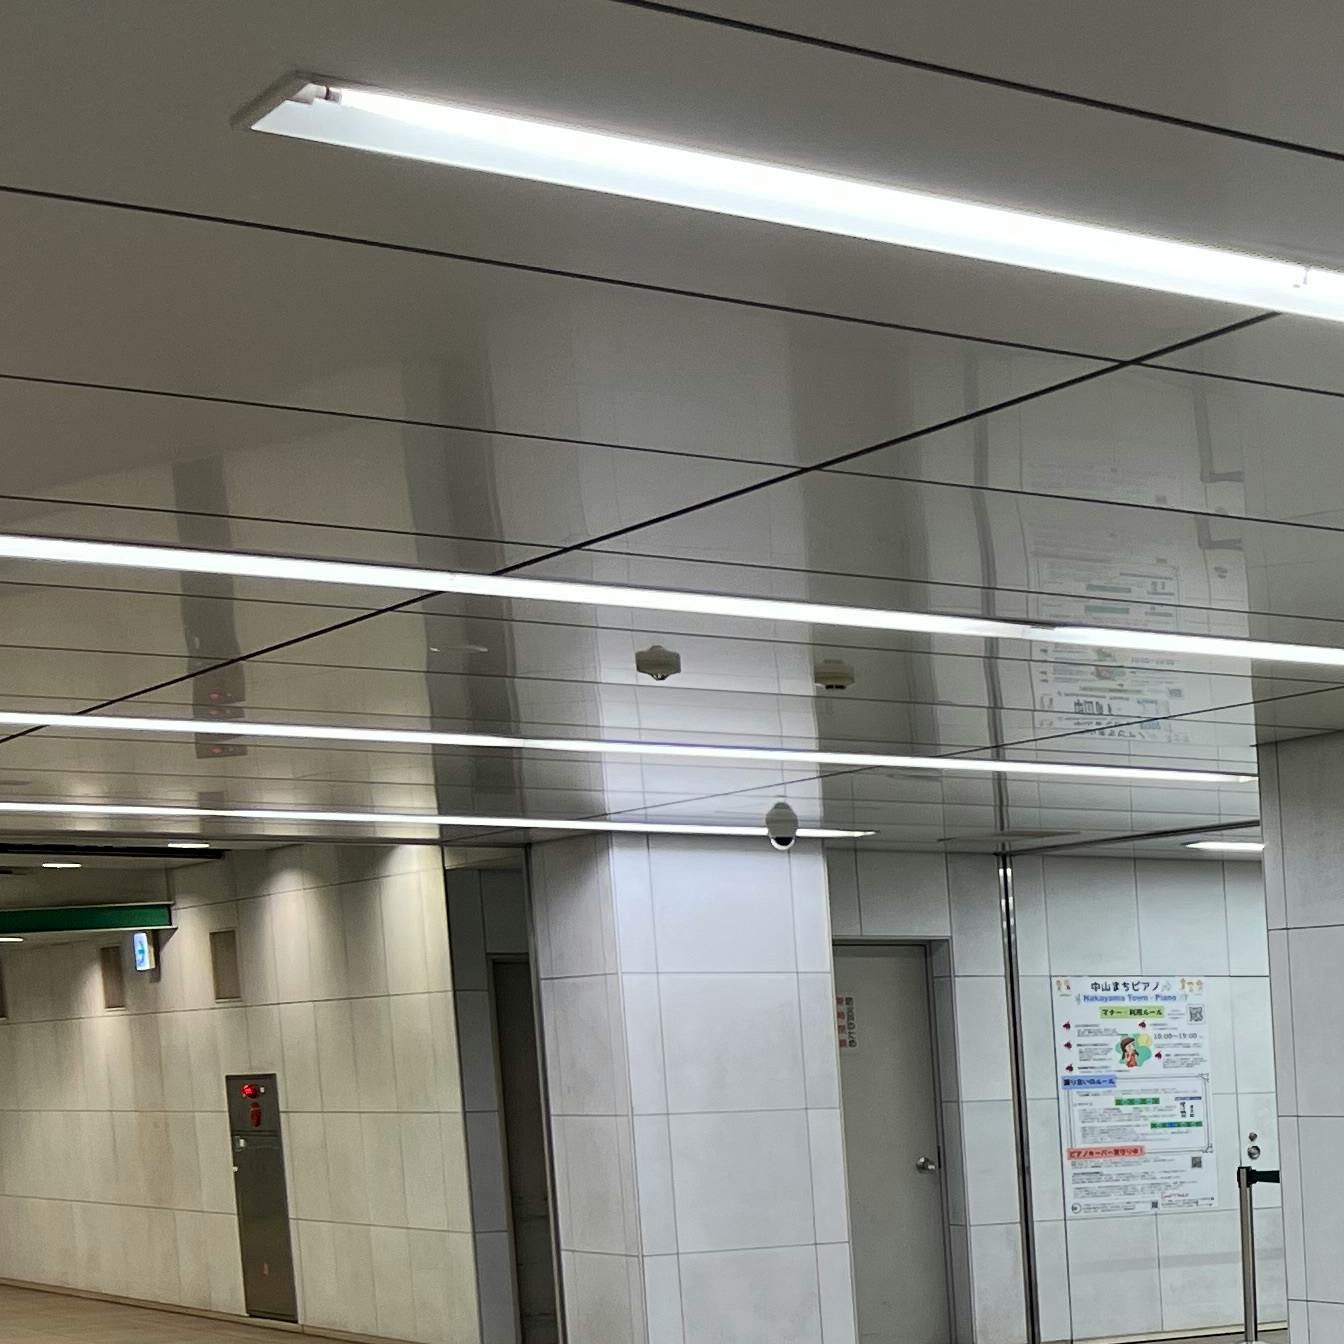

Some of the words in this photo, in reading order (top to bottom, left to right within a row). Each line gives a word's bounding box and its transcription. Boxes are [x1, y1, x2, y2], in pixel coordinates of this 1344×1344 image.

[1090, 981, 1160, 992] 中山まちピアノ
